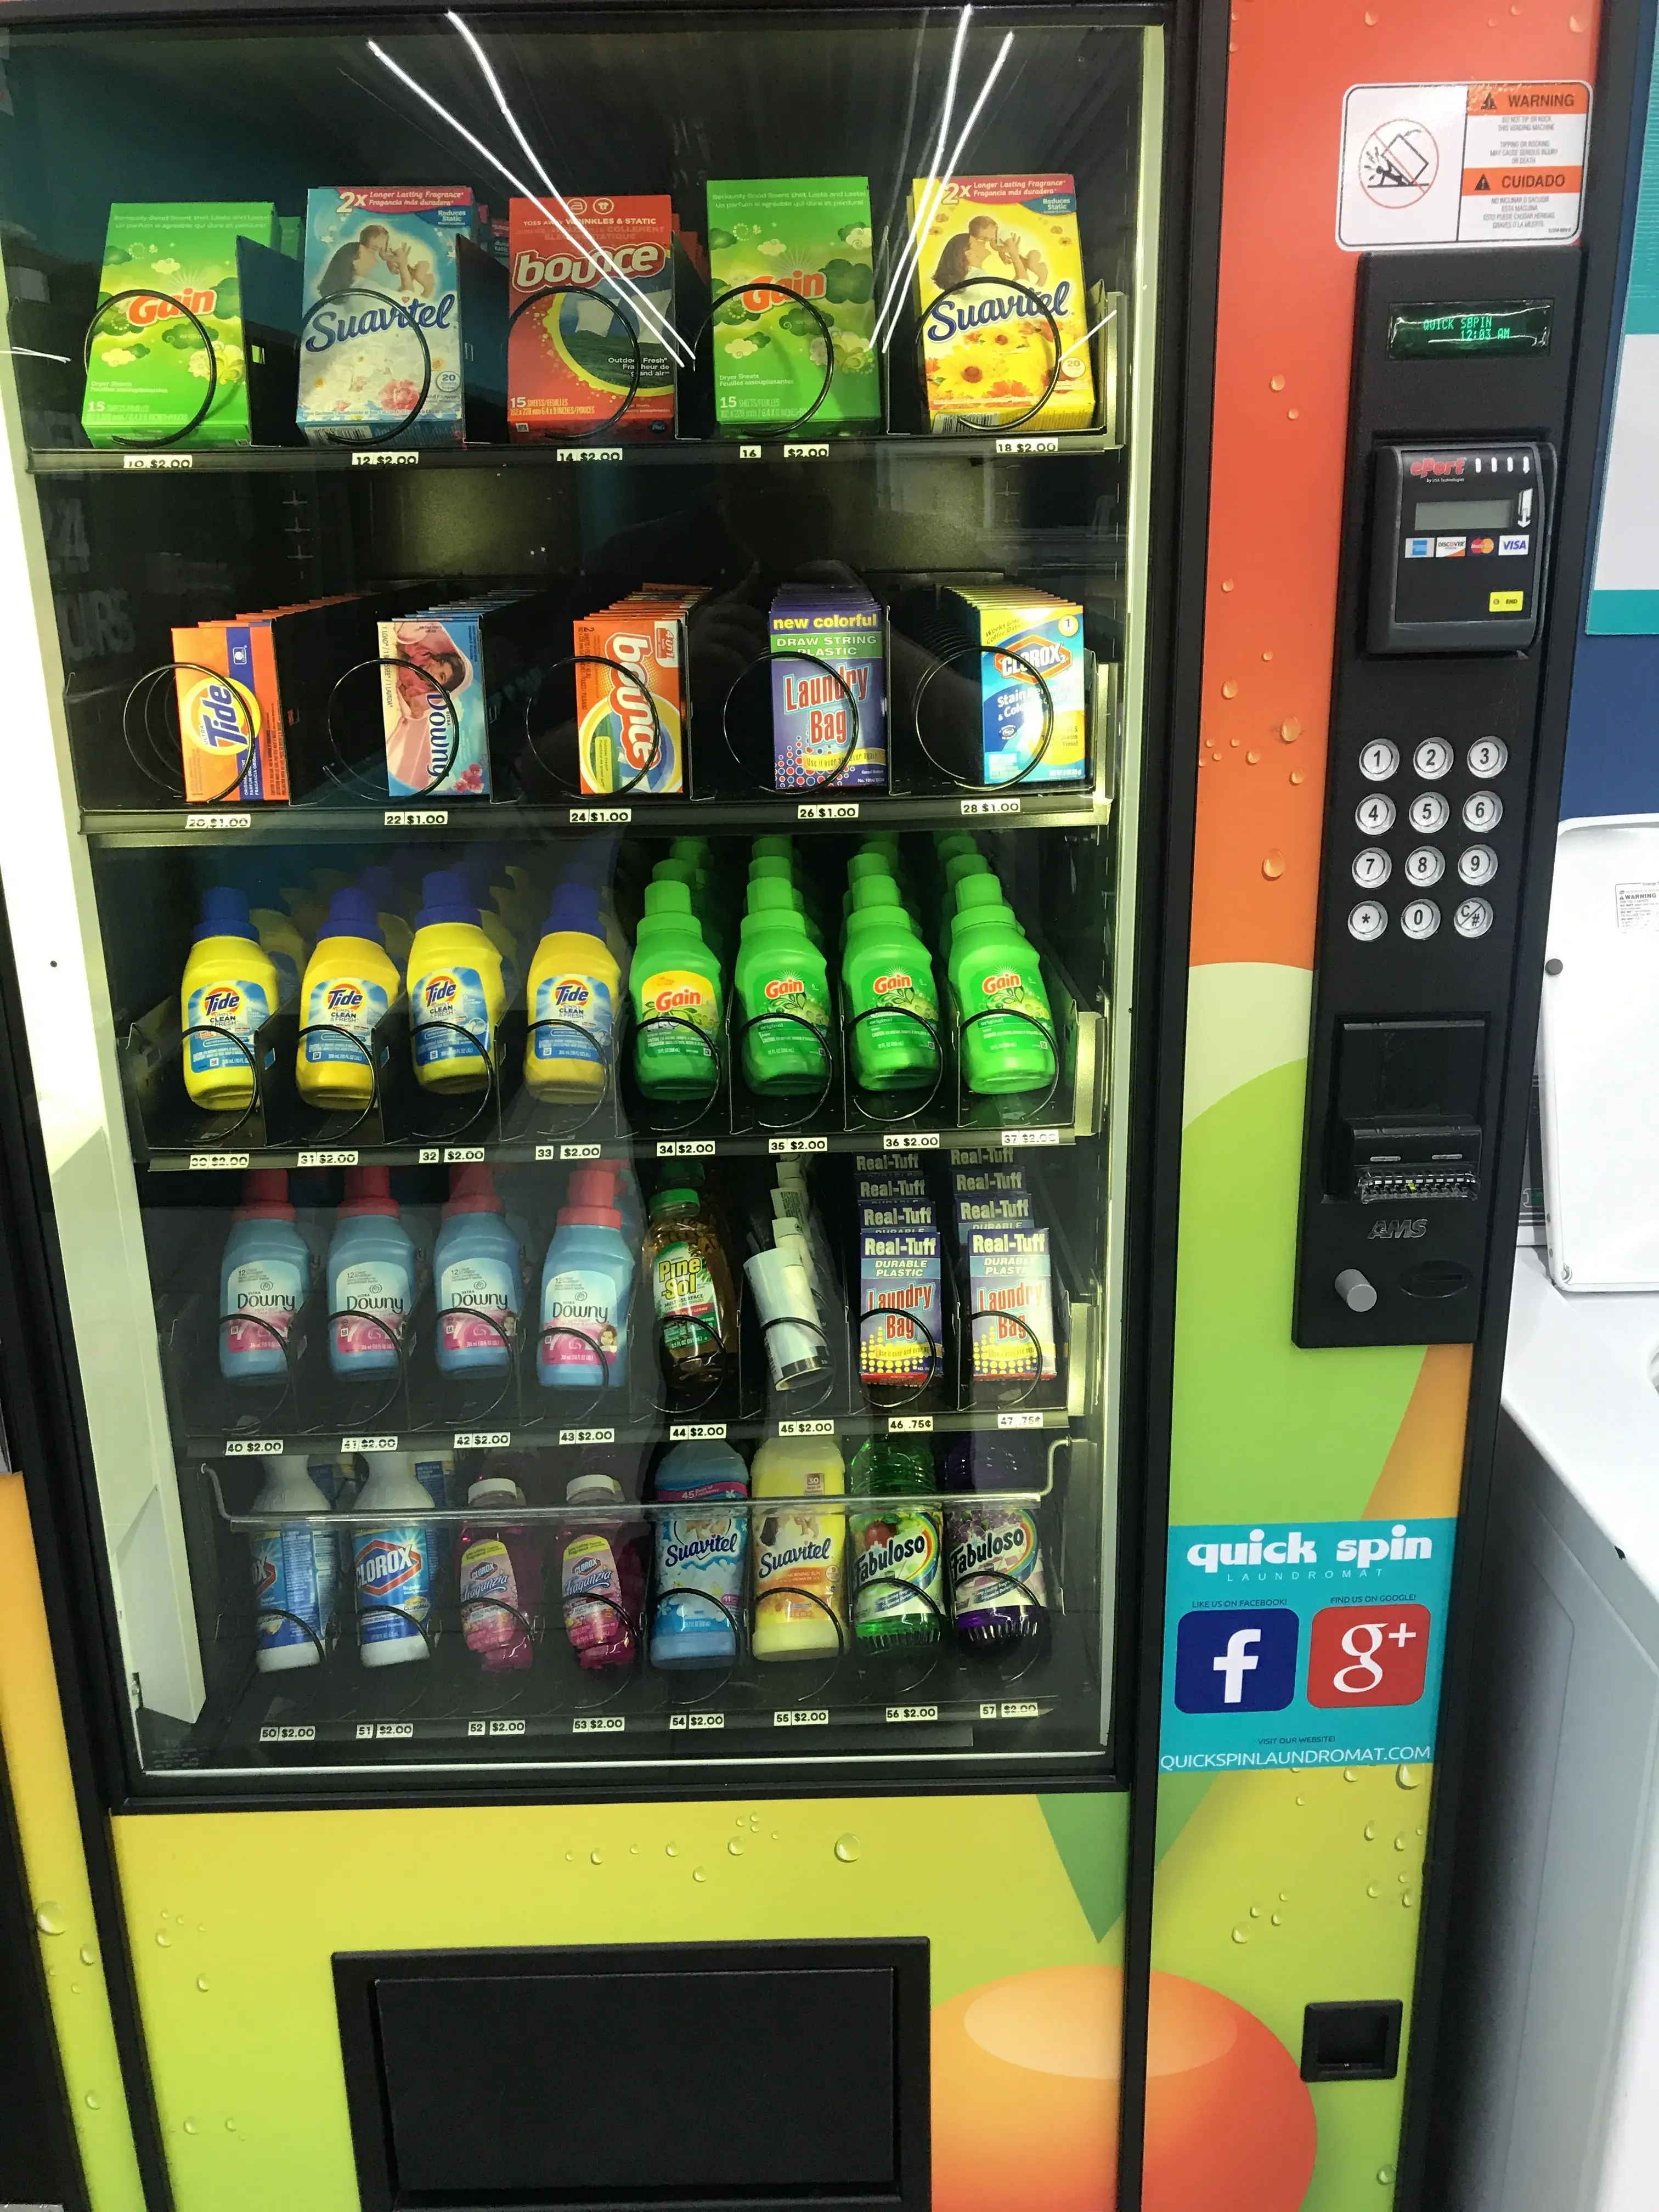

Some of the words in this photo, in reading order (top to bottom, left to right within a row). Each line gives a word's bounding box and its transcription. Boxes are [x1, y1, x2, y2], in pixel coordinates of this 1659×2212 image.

[1509, 94, 1575, 108] WARNING
[1502, 174, 1565, 188] CUIDADO
[336, 191, 368, 213] 2x
[515, 246, 658, 287] bounce
[743, 270, 826, 312] Gain
[128, 287, 216, 326] Gain
[928, 281, 1071, 342] Suavitel
[305, 294, 455, 353] Suavitel
[1423, 318, 1454, 331] QUICK
[1497, 328, 1511, 340] AM
[580, 452, 620, 461] $2.00
[788, 448, 828, 457] $2.00
[998, 444, 1012, 452] 18
[1017, 443, 1056, 453] $2.00
[377, 455, 416, 464] $2.00
[1410, 458, 1465, 478] ePort
[1504, 540, 1527, 550] VISA
[774, 616, 810, 630] new
[813, 613, 877, 629] colorful
[777, 636, 820, 647] DRAW
[824, 635, 877, 646] STRING
[797, 646, 857, 657] PLASTIC
[786, 665, 868, 713] Laundry
[997, 687, 1026, 708] Stain
[612, 635, 657, 767] bounce
[202, 685, 249, 748] Tide
[426, 693, 450, 777] Downy
[810, 708, 847, 746] Bag
[1374, 750, 1381, 767] 1
[1426, 749, 1436, 766] 2
[1480, 748, 1489, 765] 3
[800, 809, 815, 817] 26
[818, 808, 856, 817] $1.00
[963, 804, 977, 812] 28
[982, 803, 1019, 812] $1.00
[1368, 804, 1379, 821] 4
[1422, 803, 1432, 820] 5
[1475, 802, 1485, 819] 6
[386, 816, 400, 824] 22
[407, 815, 445, 825] $1.00
[572, 813, 586, 821] 24
[591, 812, 629, 821] $1.00
[1366, 858, 1375, 874] 7
[1418, 856, 1427, 873] 8
[1471, 855, 1480, 872] 9
[1414, 909, 1423, 926] 0
[426, 981, 456, 1003] Tide
[765, 979, 804, 998] Gain
[873, 974, 912, 994] Gain
[983, 973, 1022, 994] Gain
[328, 989, 363, 1009] Tide
[555, 985, 589, 1006] Tide
[657, 989, 701, 1012] Gain
[205, 992, 240, 1017] Tide
[659, 1146, 673, 1154] 34
[678, 1144, 713, 1154] $2.00
[771, 1142, 785, 1150] 35
[791, 1141, 825, 1150] $2.00
[886, 1138, 899, 1147] 36
[904, 1137, 938, 1147] $2.00
[538, 1149, 552, 1157] 33
[564, 1147, 600, 1157] $2.00
[860, 1180, 926, 1198] Real-Tuff
[864, 1207, 932, 1226] Real-Tuff
[961, 1200, 1029, 1220] Real-Tuff
[1368, 1218, 1427, 1239] AMS
[865, 1238, 937, 1256] Real-Tuff
[973, 1233, 1046, 1252] Real-Tuff
[658, 1257, 702, 1283] Pine
[874, 1260, 928, 1268] DURABLE
[876, 1268, 924, 1277] PLASTIC
[662, 1272, 697, 1300] -Sol
[238, 1293, 296, 1311] Downy
[346, 1295, 403, 1311] Downy
[451, 1292, 508, 1310] Downy
[868, 1284, 932, 1312] Laundry
[978, 1282, 1043, 1312] Laundry
[552, 1302, 608, 1324] Downy
[886, 1313, 915, 1339] Bag
[998, 1313, 1028, 1339] Bag
[673, 1429, 686, 1437] 44
[690, 1426, 724, 1436] $2.00
[781, 1424, 793, 1432] 45
[798, 1423, 832, 1432] $2.00
[890, 1420, 902, 1429] 46
[909, 1419, 932, 1429] .75¢
[561, 1432, 574, 1441] 43
[578, 1431, 612, 1441] $2.00
[665, 1533, 738, 1567] Suavitel
[950, 1528, 1024, 1582] Fabuloso
[1187, 1528, 1317, 1573] quick
[1336, 1524, 1432, 1568] spin
[356, 1543, 414, 1590] CLOROX
[758, 1538, 832, 1578] Suavitel
[856, 1536, 925, 1585] Fabuloso
[472, 1563, 495, 1581] CLOROX
[574, 1559, 597, 1575] CLOROX
[1227, 1567, 1383, 1582] LAUNDROMAT
[1239, 1598, 1288, 1607] FACEBOOK!
[1330, 1595, 1350, 1604] FIND
[1379, 1593, 1417, 1602] GOOGLE!
[1213, 1628, 1261, 1703] f
[1333, 1622, 1417, 1694] g+
[672, 1718, 685, 1726] 54
[691, 1716, 723, 1725] $2.00
[776, 1714, 789, 1723] 55
[794, 1712, 827, 1722] $2.00
[887, 1710, 899, 1718] 56
[904, 1708, 936, 1718] $2.00
[262, 1729, 277, 1737] 50
[281, 1728, 314, 1737] $2.00
[470, 1724, 483, 1732] 52
[492, 1722, 524, 1732] $2.00
[575, 1720, 587, 1729] 53
[590, 1719, 623, 1729] $2.00
[1258, 1736, 1277, 1745] VISIT
[1279, 1736, 1297, 1744] OUR
[1299, 1735, 1335, 1743] WEBSITE!
[1160, 1745, 1431, 1770] QUICKSPINLAUNDROMAT.COM
